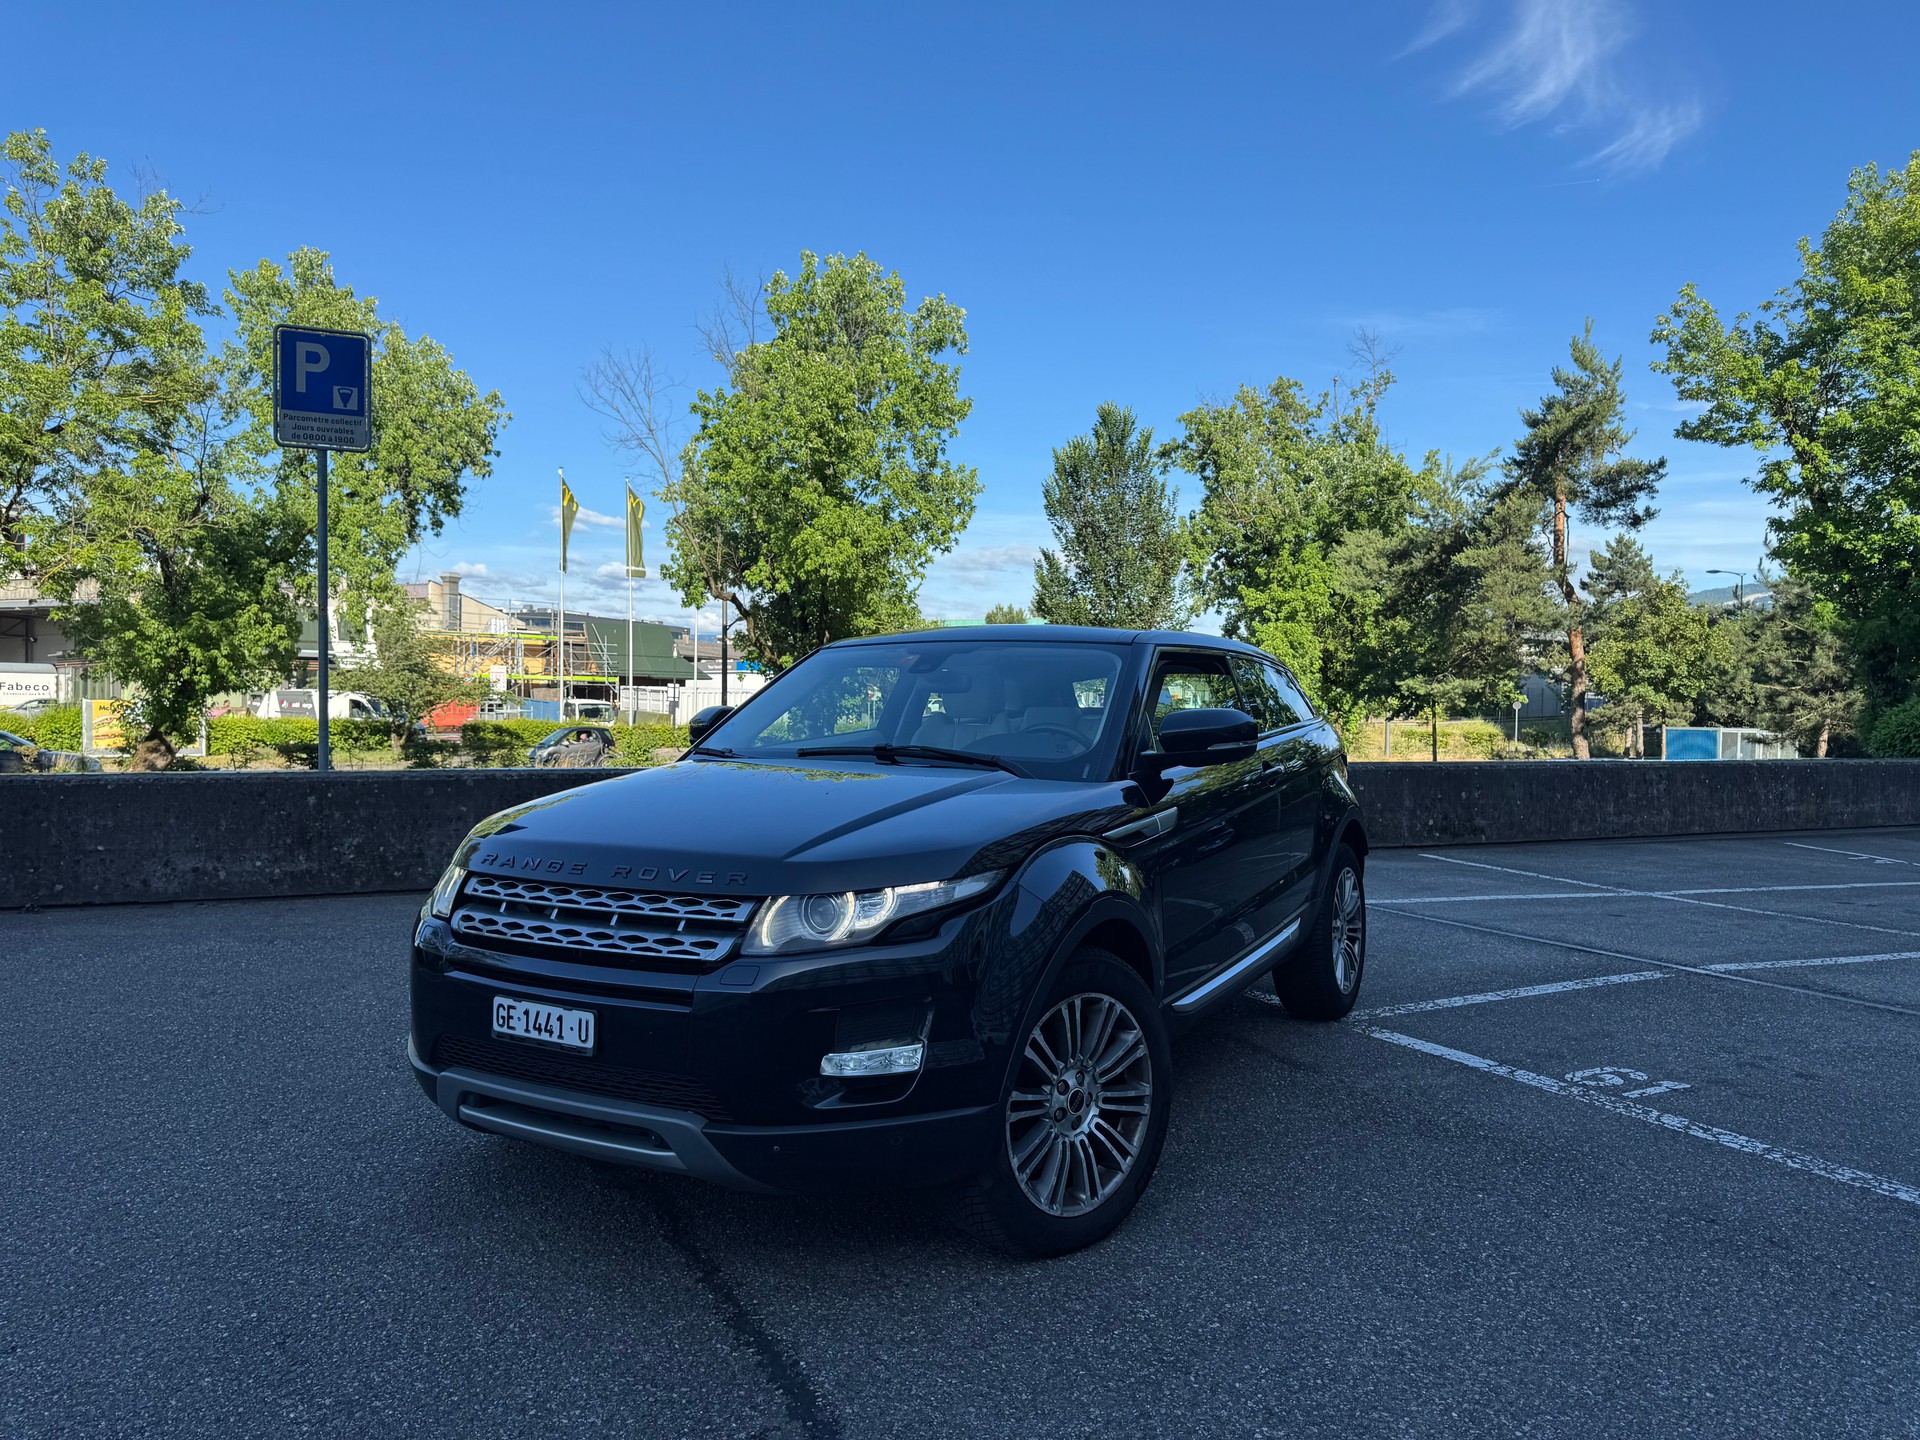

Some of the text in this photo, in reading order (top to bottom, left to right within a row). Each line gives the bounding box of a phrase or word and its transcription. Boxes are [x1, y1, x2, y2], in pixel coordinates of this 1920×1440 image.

[295, 341, 330, 393] P
[330, 418, 362, 427] collectif
[291, 423, 355, 435] Jours ouvrables
[291, 432, 301, 440] de
[0, 682, 49, 691] Fabeco
[480, 852, 749, 886] RANGE ROVER
